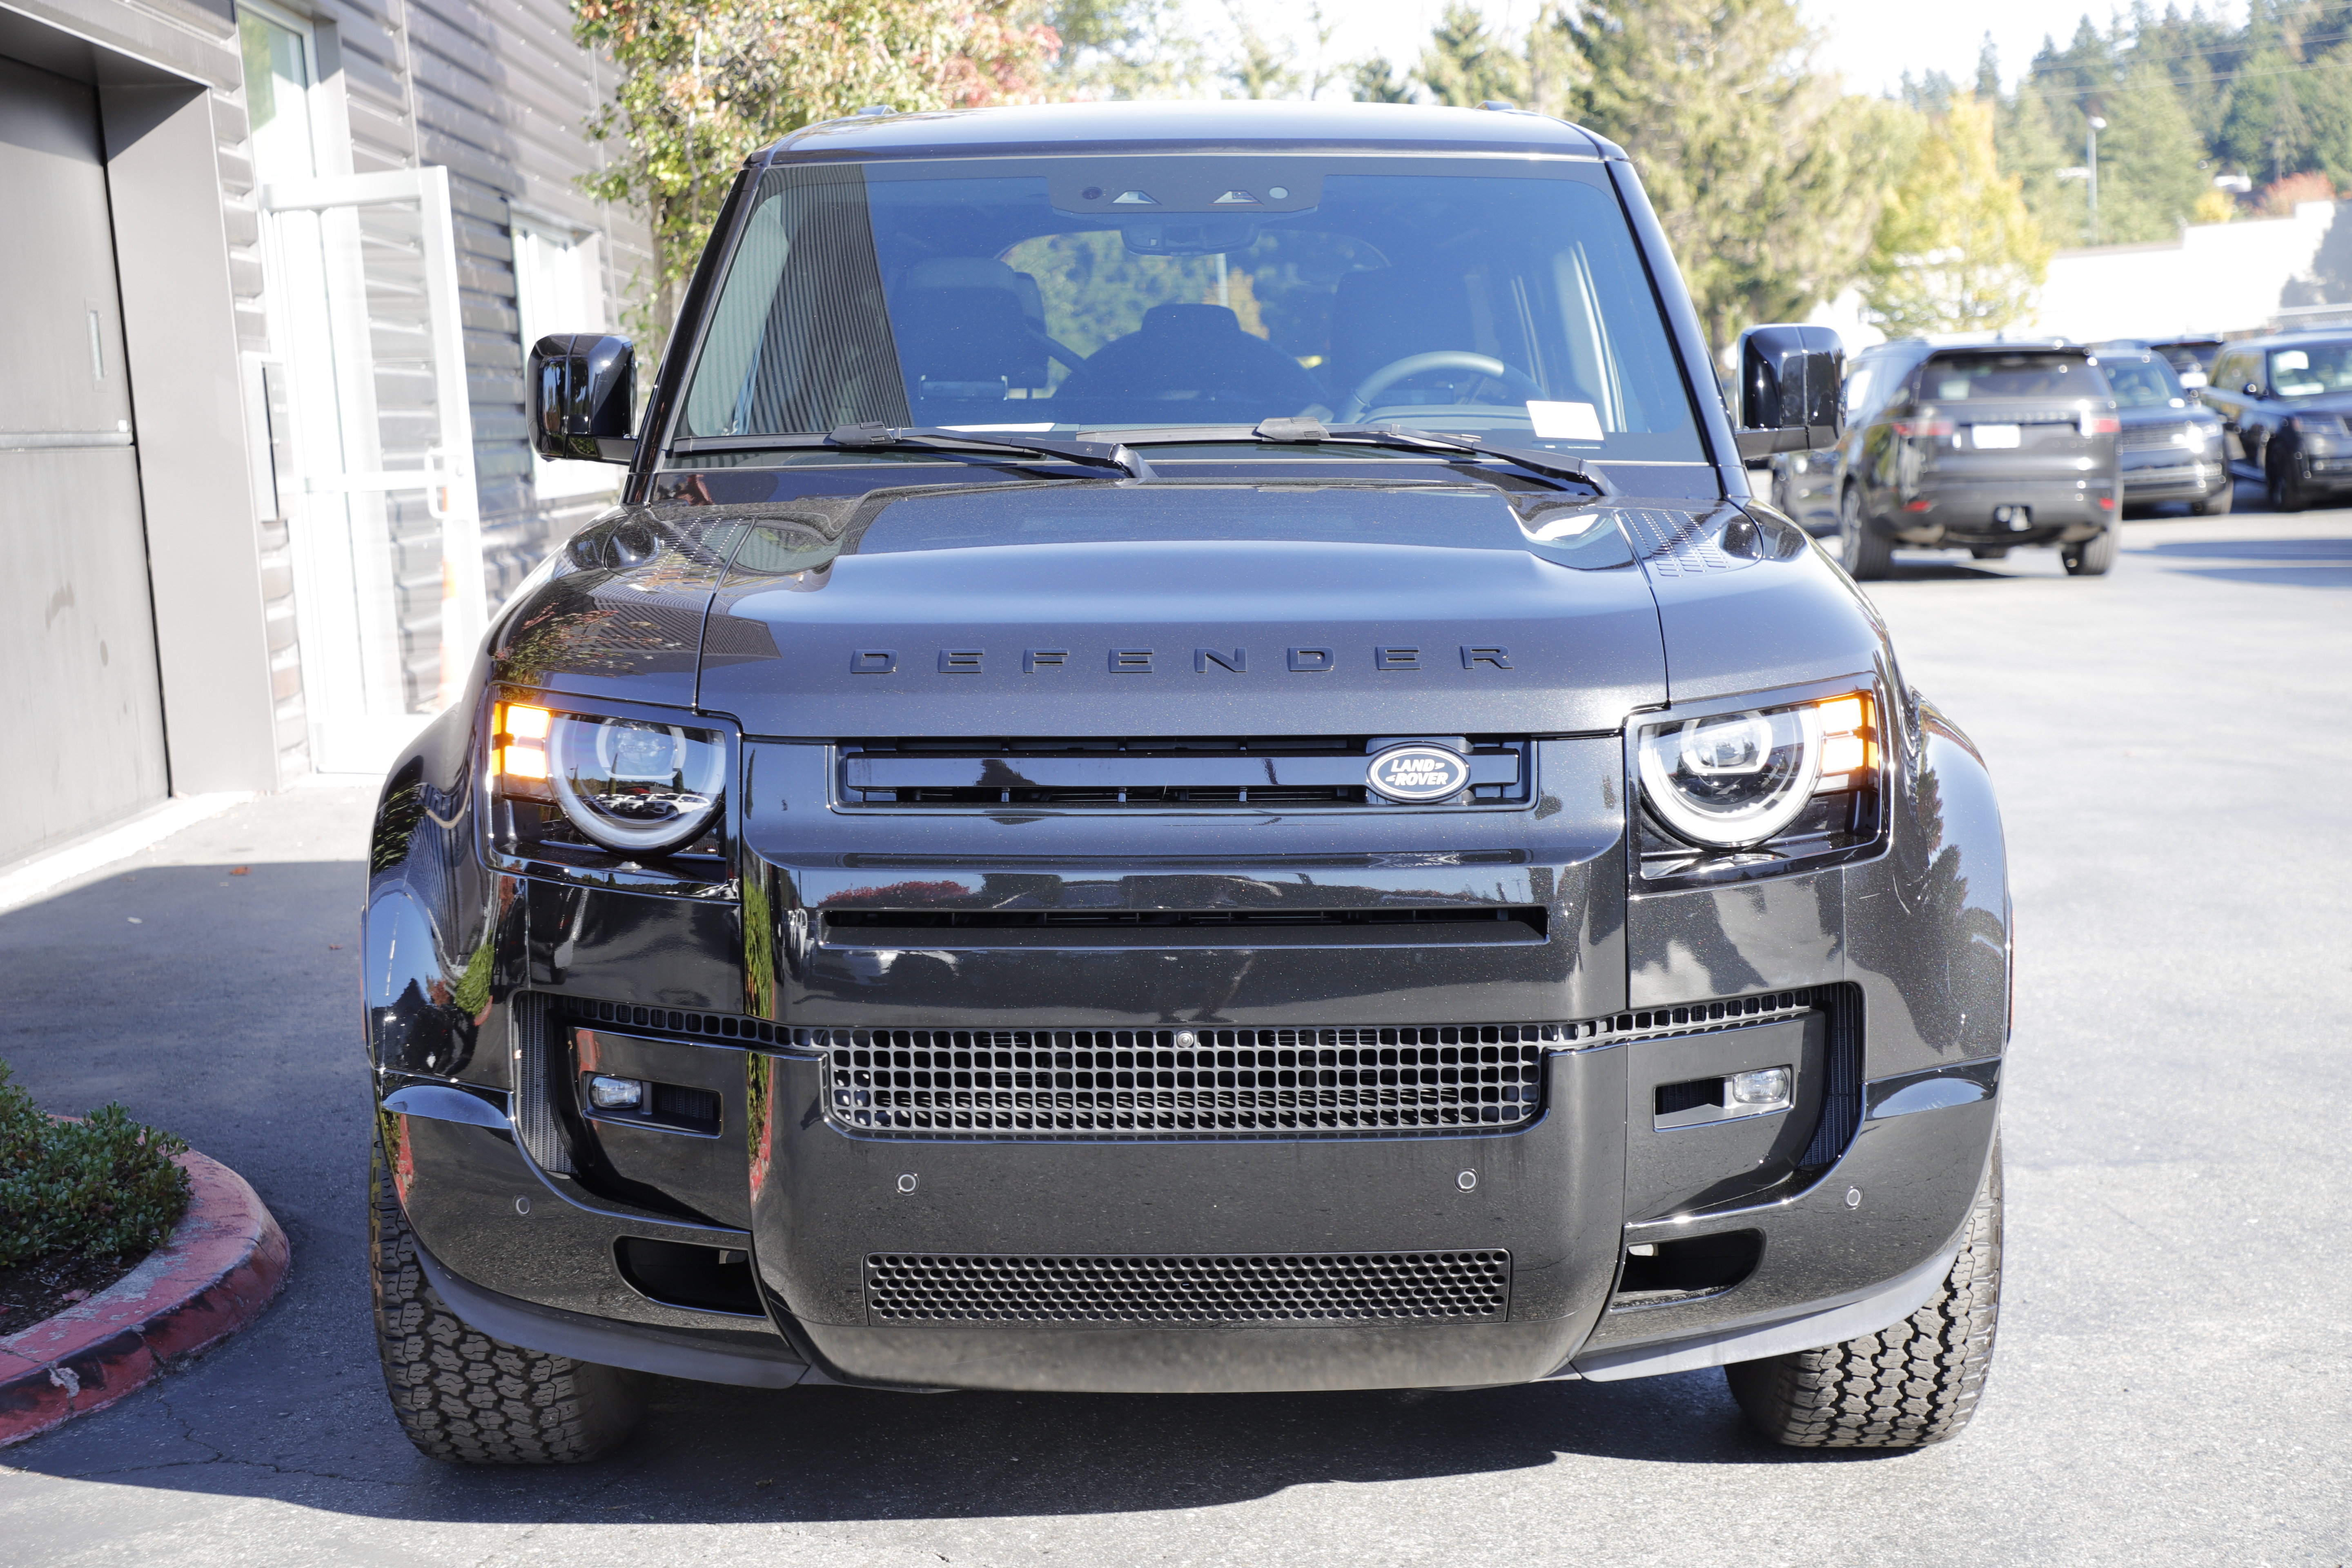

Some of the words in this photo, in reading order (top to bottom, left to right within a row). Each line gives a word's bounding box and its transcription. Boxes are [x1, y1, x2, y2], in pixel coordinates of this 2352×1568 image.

[850, 644, 1515, 673] DEFENDER
[1391, 759, 1435, 772] LAND
[1394, 772, 1449, 786] ROVER
